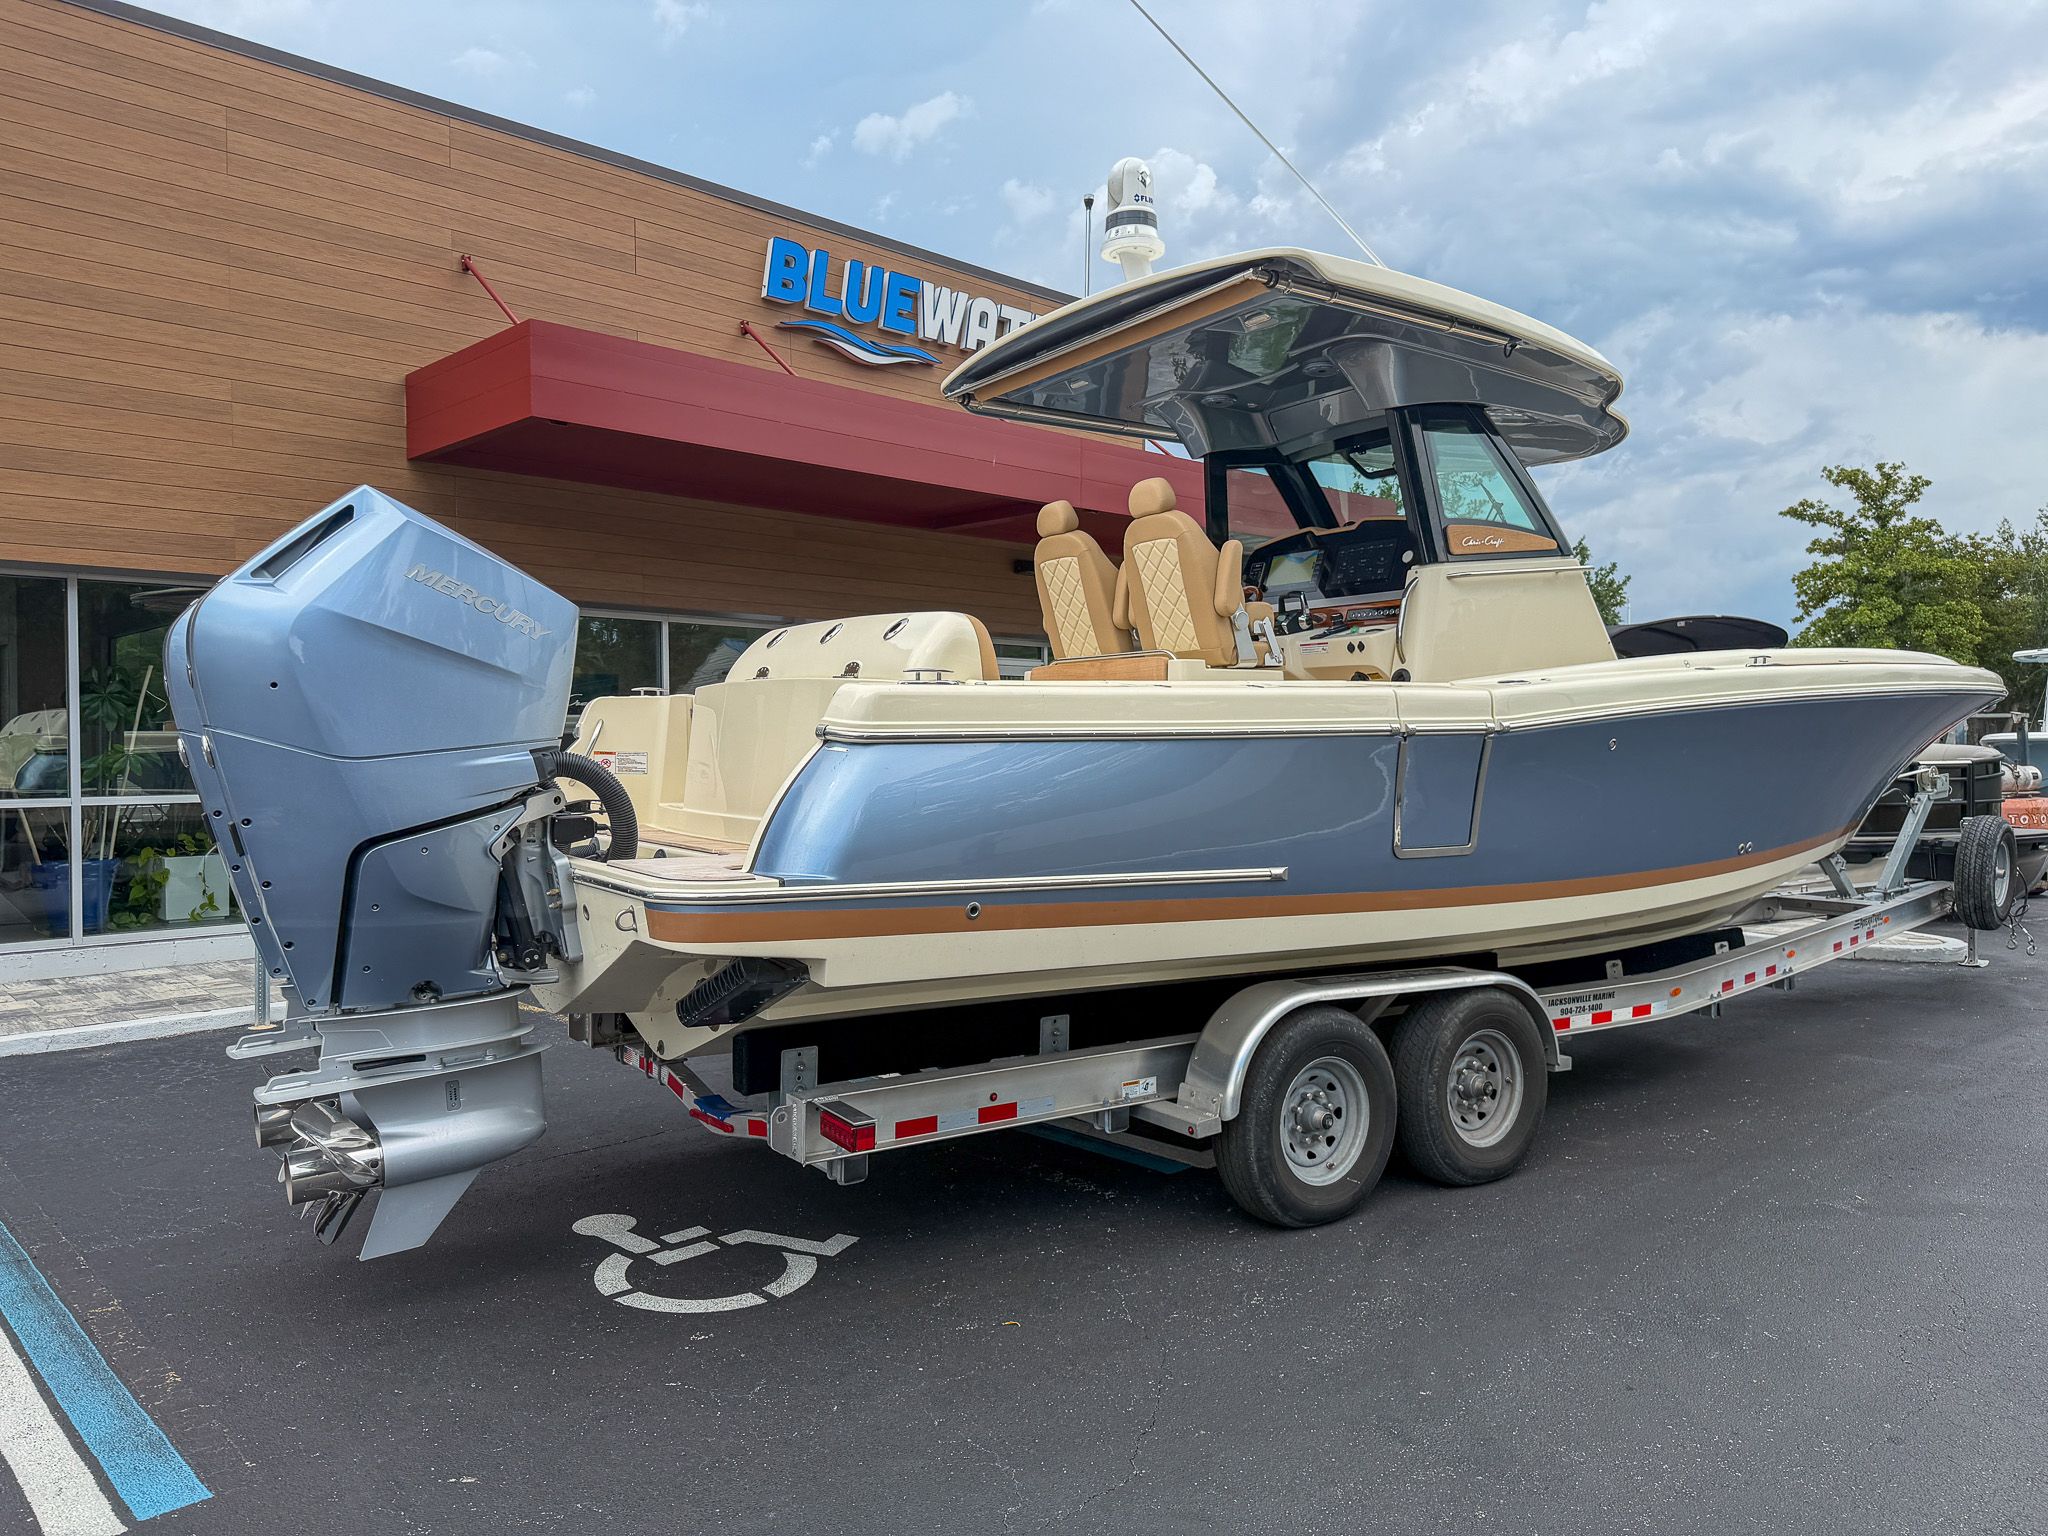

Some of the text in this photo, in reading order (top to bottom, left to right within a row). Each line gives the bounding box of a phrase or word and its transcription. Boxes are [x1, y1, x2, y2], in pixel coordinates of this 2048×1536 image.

[761, 236, 1042, 352] BLUEWAT
[404, 563, 552, 640] MERCURY
[2008, 814, 2048, 825] TOYO
[1548, 991, 1616, 1007] JACKSONVILLE MARINE
[1560, 1003, 1603, 1016] 904-724-1400
